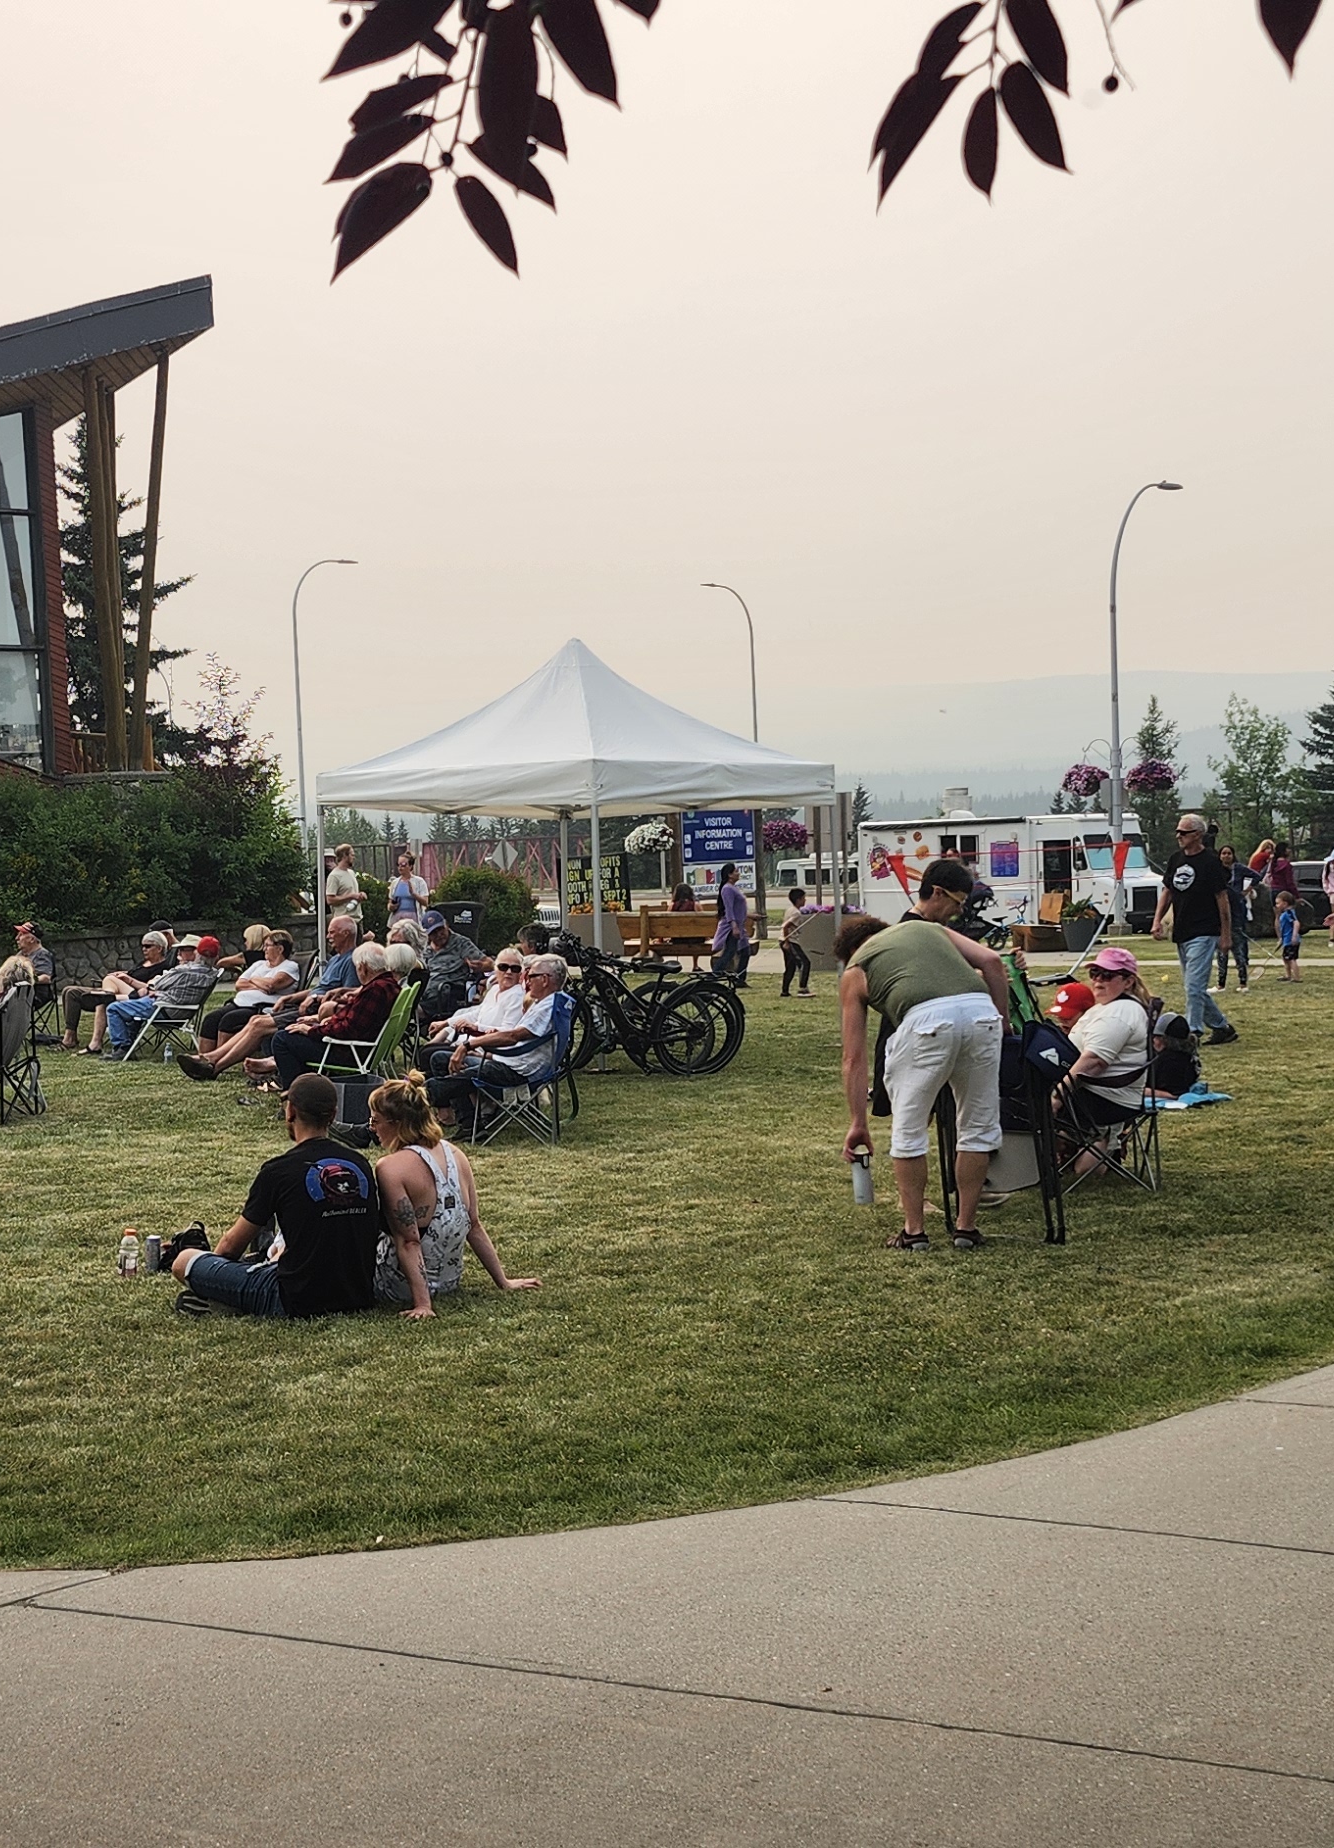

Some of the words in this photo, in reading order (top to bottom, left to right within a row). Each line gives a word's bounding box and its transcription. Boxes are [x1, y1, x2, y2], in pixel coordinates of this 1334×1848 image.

[704, 817, 732, 826] VISITOR
[694, 828, 743, 839] INFORMATION
[704, 840, 734, 851] CENTRE
[599, 855, 620, 868] OFITS
[567, 870, 580, 881] IGN
[567, 881, 587, 893] OOTH
[600, 879, 610, 890] EG
[603, 889, 620, 901] SEPT
